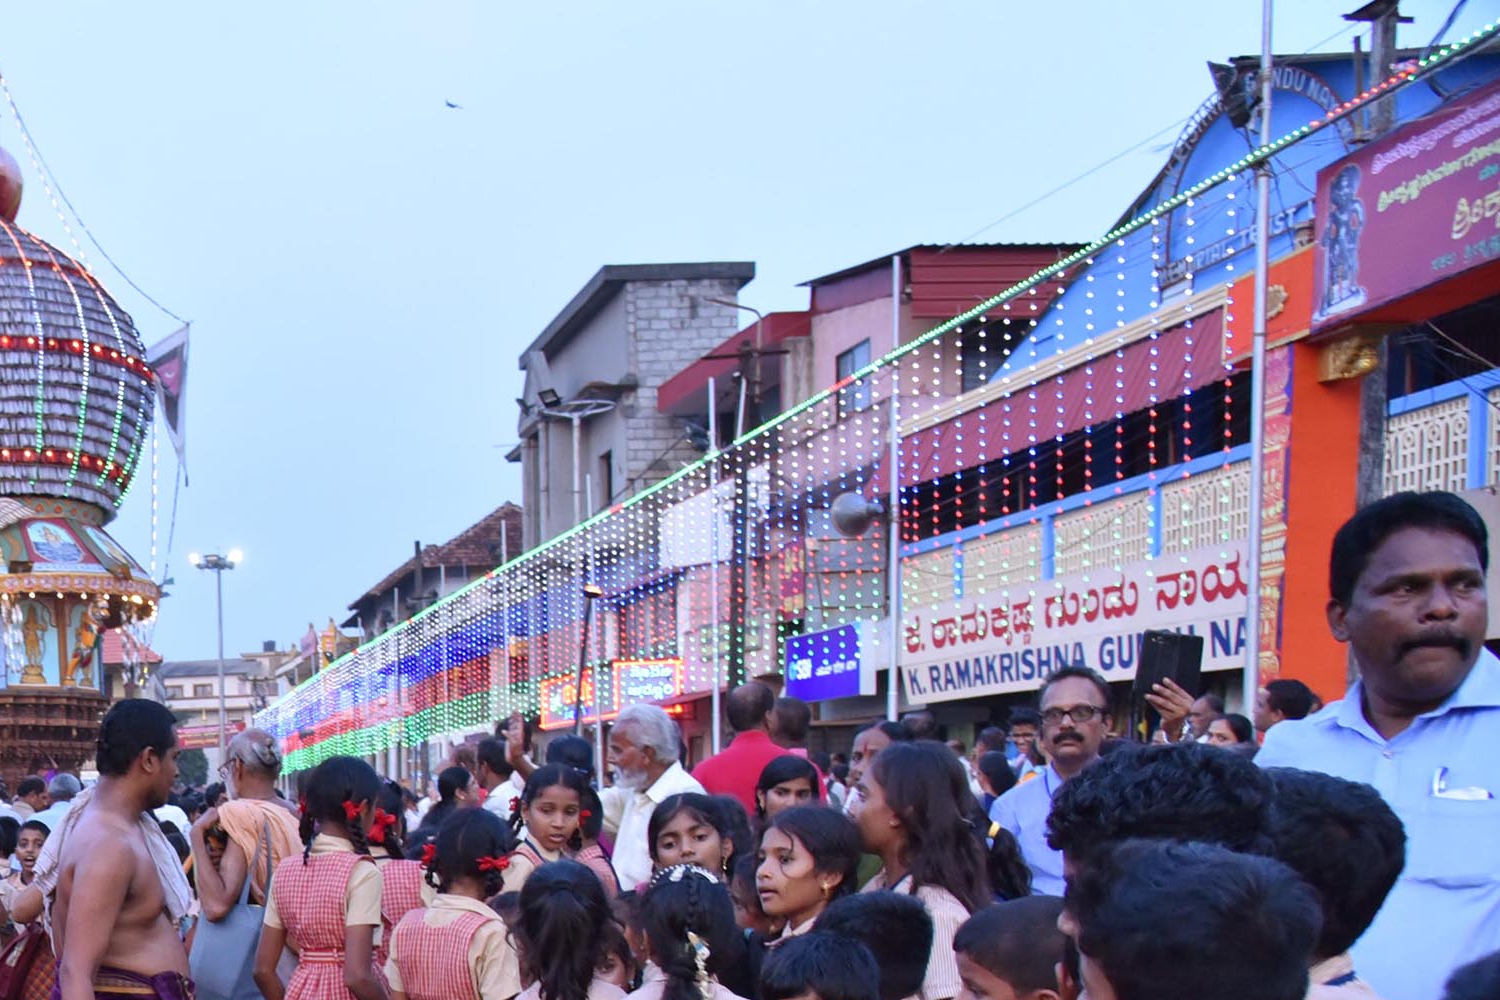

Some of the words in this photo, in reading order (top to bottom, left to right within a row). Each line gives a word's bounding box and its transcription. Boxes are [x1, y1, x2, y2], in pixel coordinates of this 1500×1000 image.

[931, 595, 1035, 647] ರಾಮಕೃಷ್ಣ
[1044, 573, 1139, 629] ಗುಂಡು
[908, 668, 926, 696] K.
[929, 641, 1087, 693] RAMAKRISHNA
